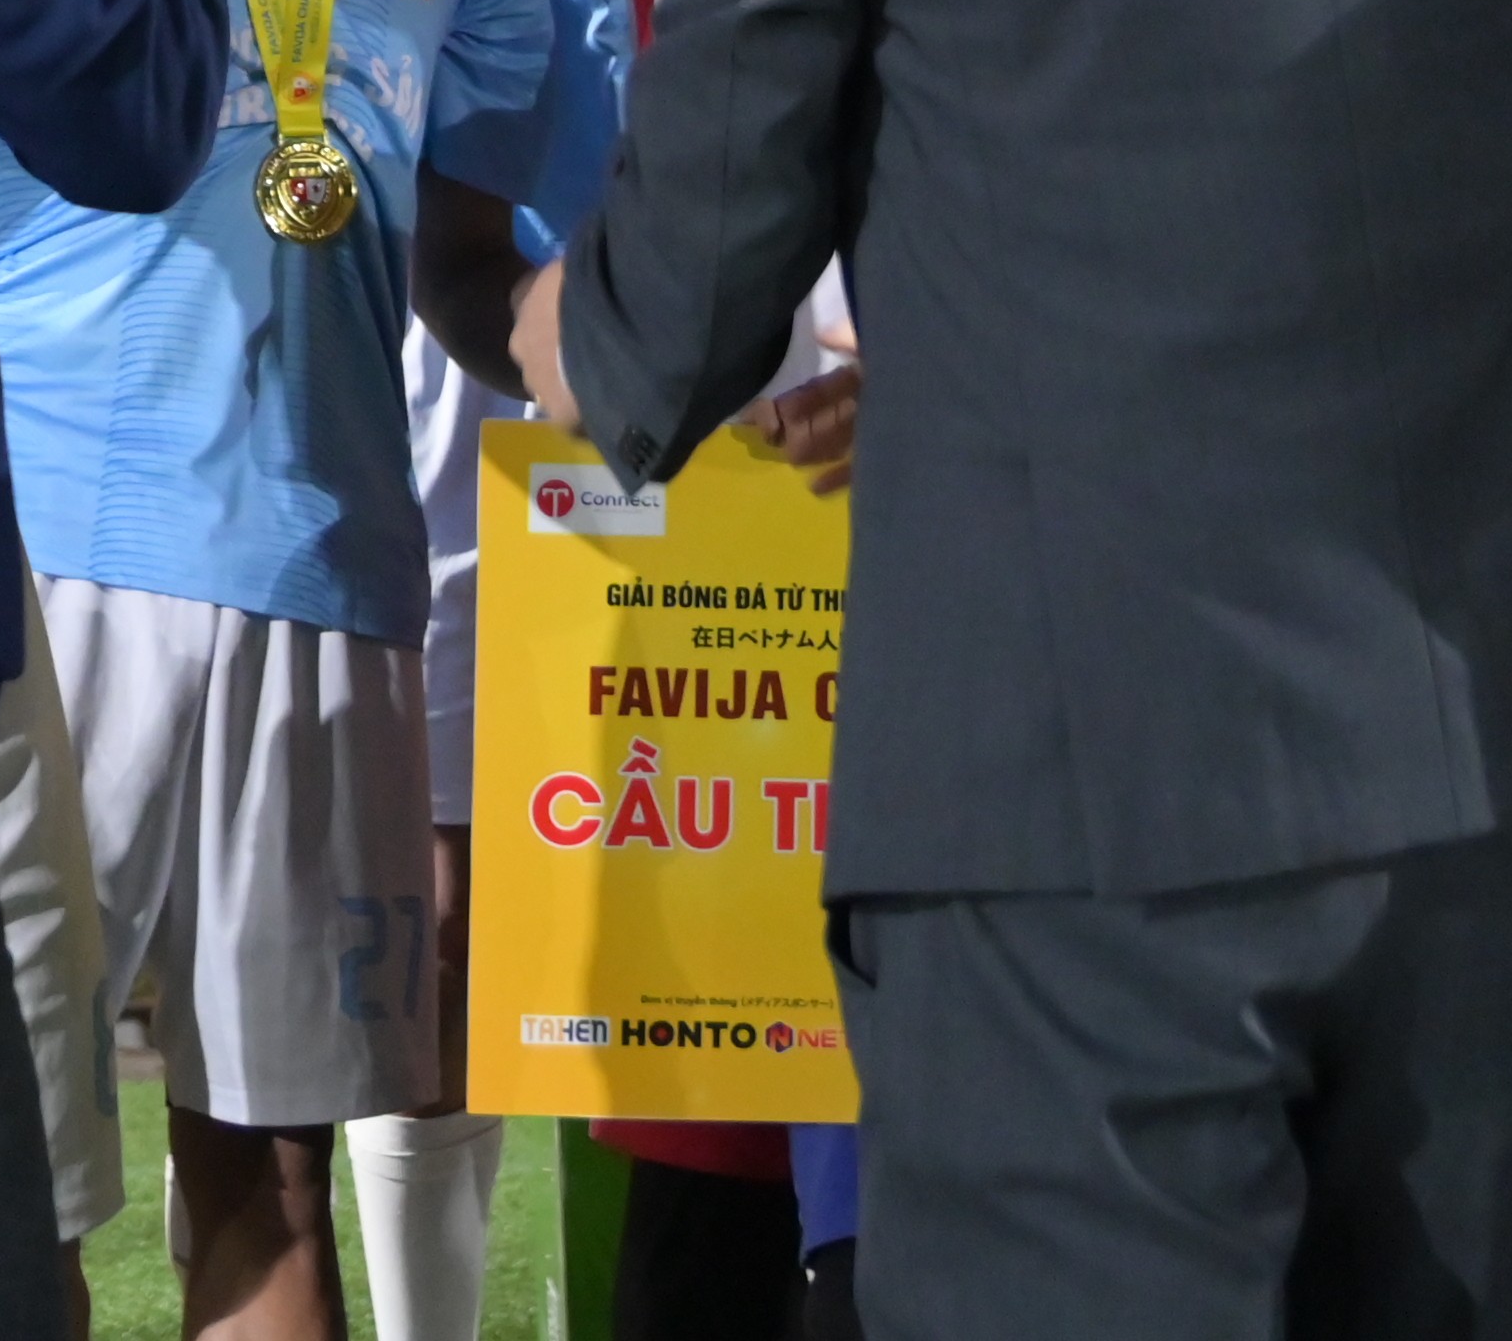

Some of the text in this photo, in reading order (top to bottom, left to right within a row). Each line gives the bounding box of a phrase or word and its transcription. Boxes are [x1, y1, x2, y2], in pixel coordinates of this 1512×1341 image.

[291, 22, 306, 64] FAVIJA
[580, 491, 660, 509] Connect
[606, 575, 654, 607] GIẢI
[662, 580, 727, 609] BÓNG
[735, 581, 767, 610] ĐÁ
[774, 582, 806, 612] TỪ
[588, 666, 789, 721] FAVIJA
[528, 736, 734, 850] CẦU
[620, 1019, 757, 1049] HONTO
